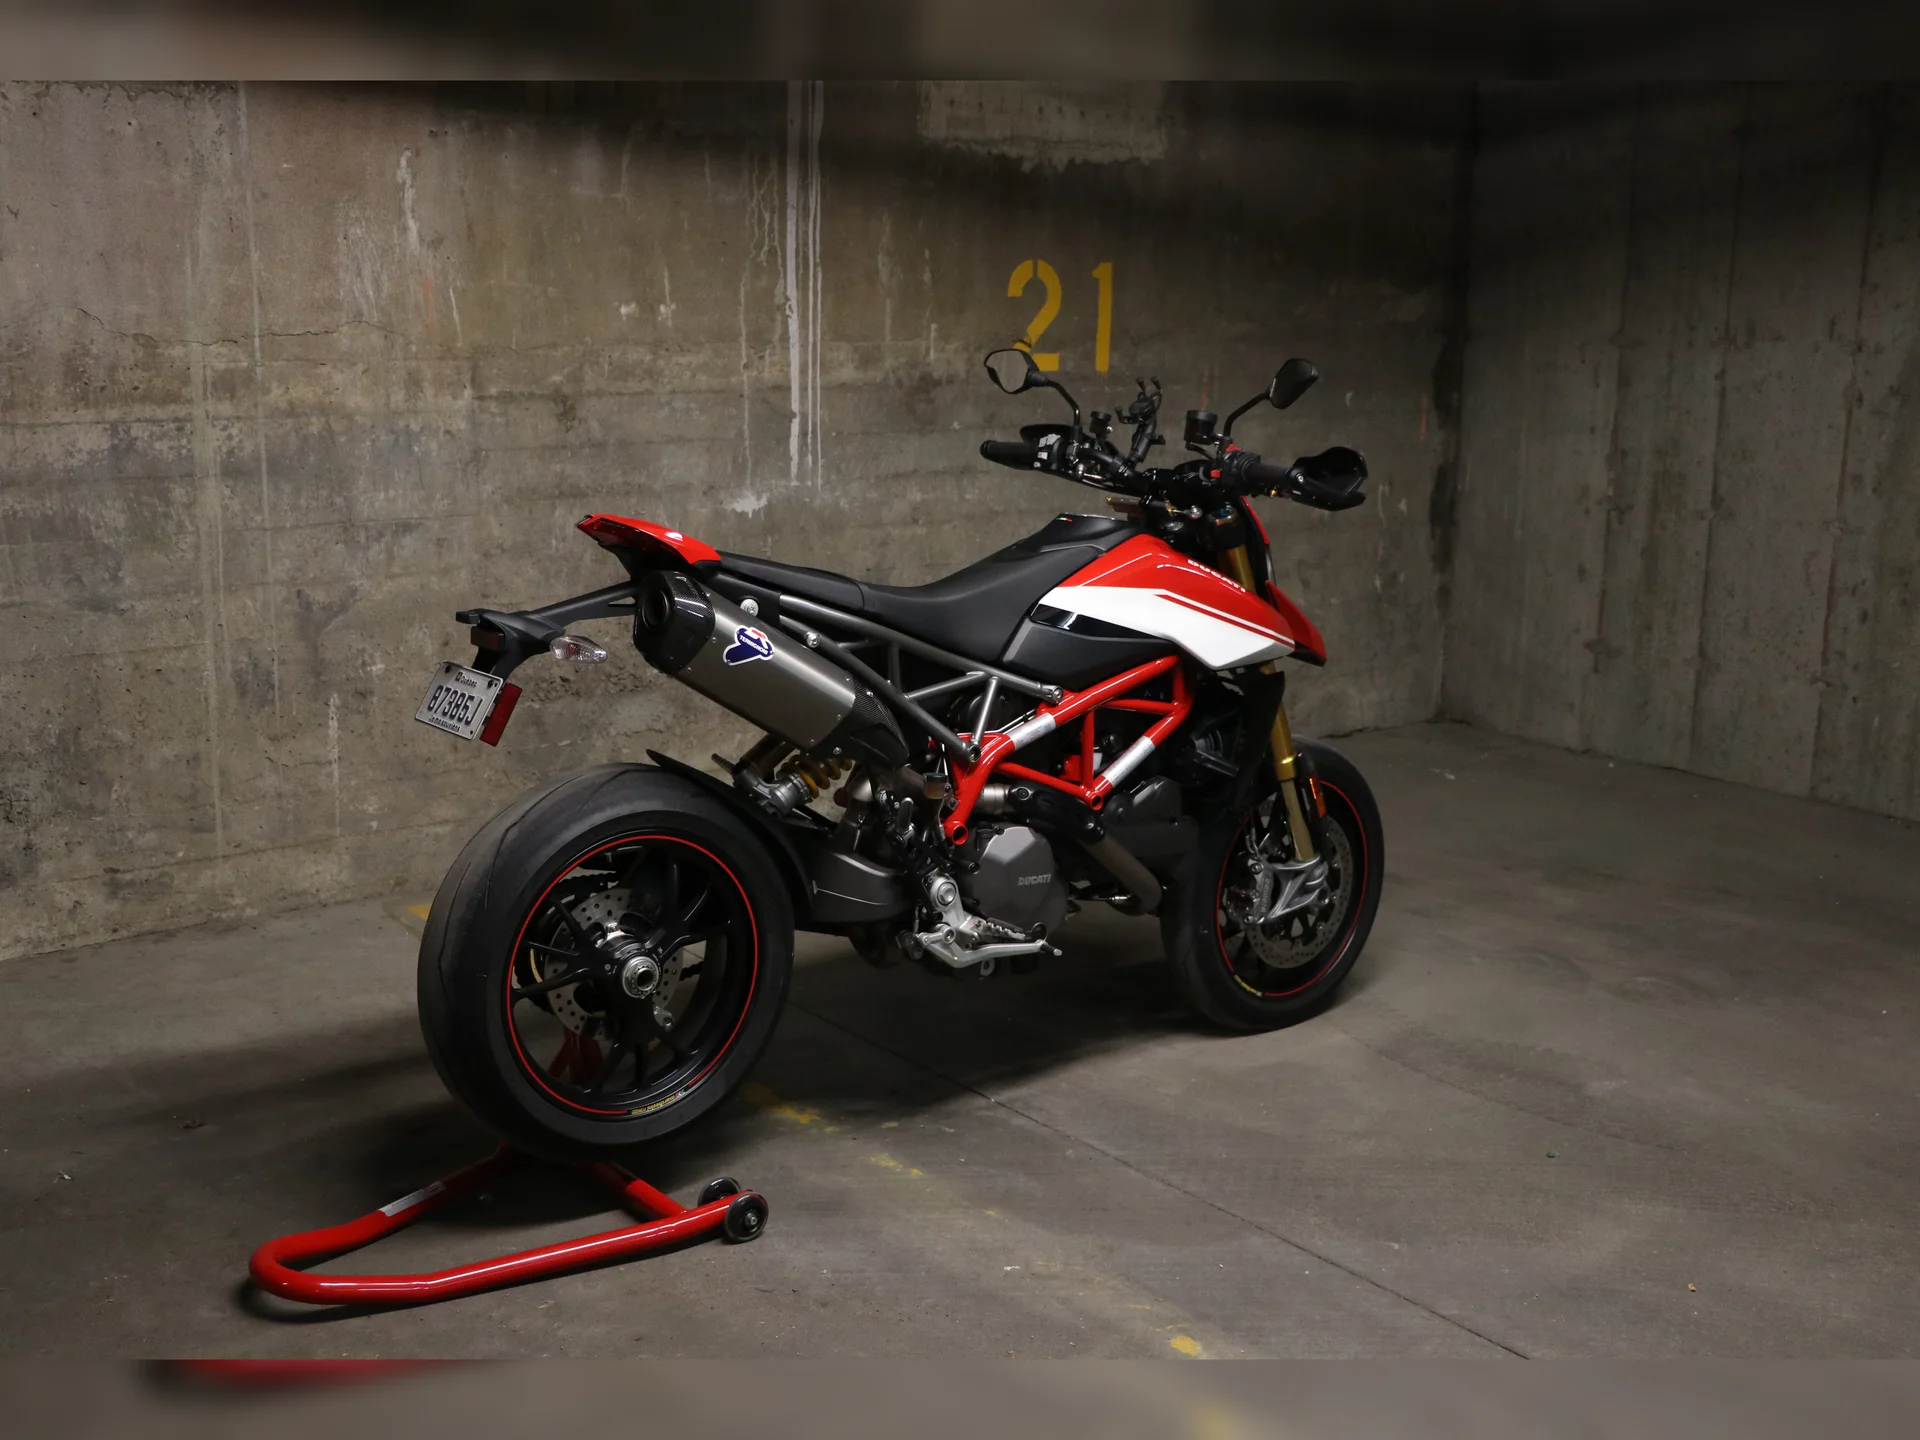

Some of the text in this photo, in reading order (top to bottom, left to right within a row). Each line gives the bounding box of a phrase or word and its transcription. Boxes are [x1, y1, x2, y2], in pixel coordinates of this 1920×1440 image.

[1007, 259, 1112, 373] 21
[1187, 559, 1246, 593] DUCATI
[427, 684, 483, 726] 87385J
[1017, 873, 1051, 887] DUCATI
